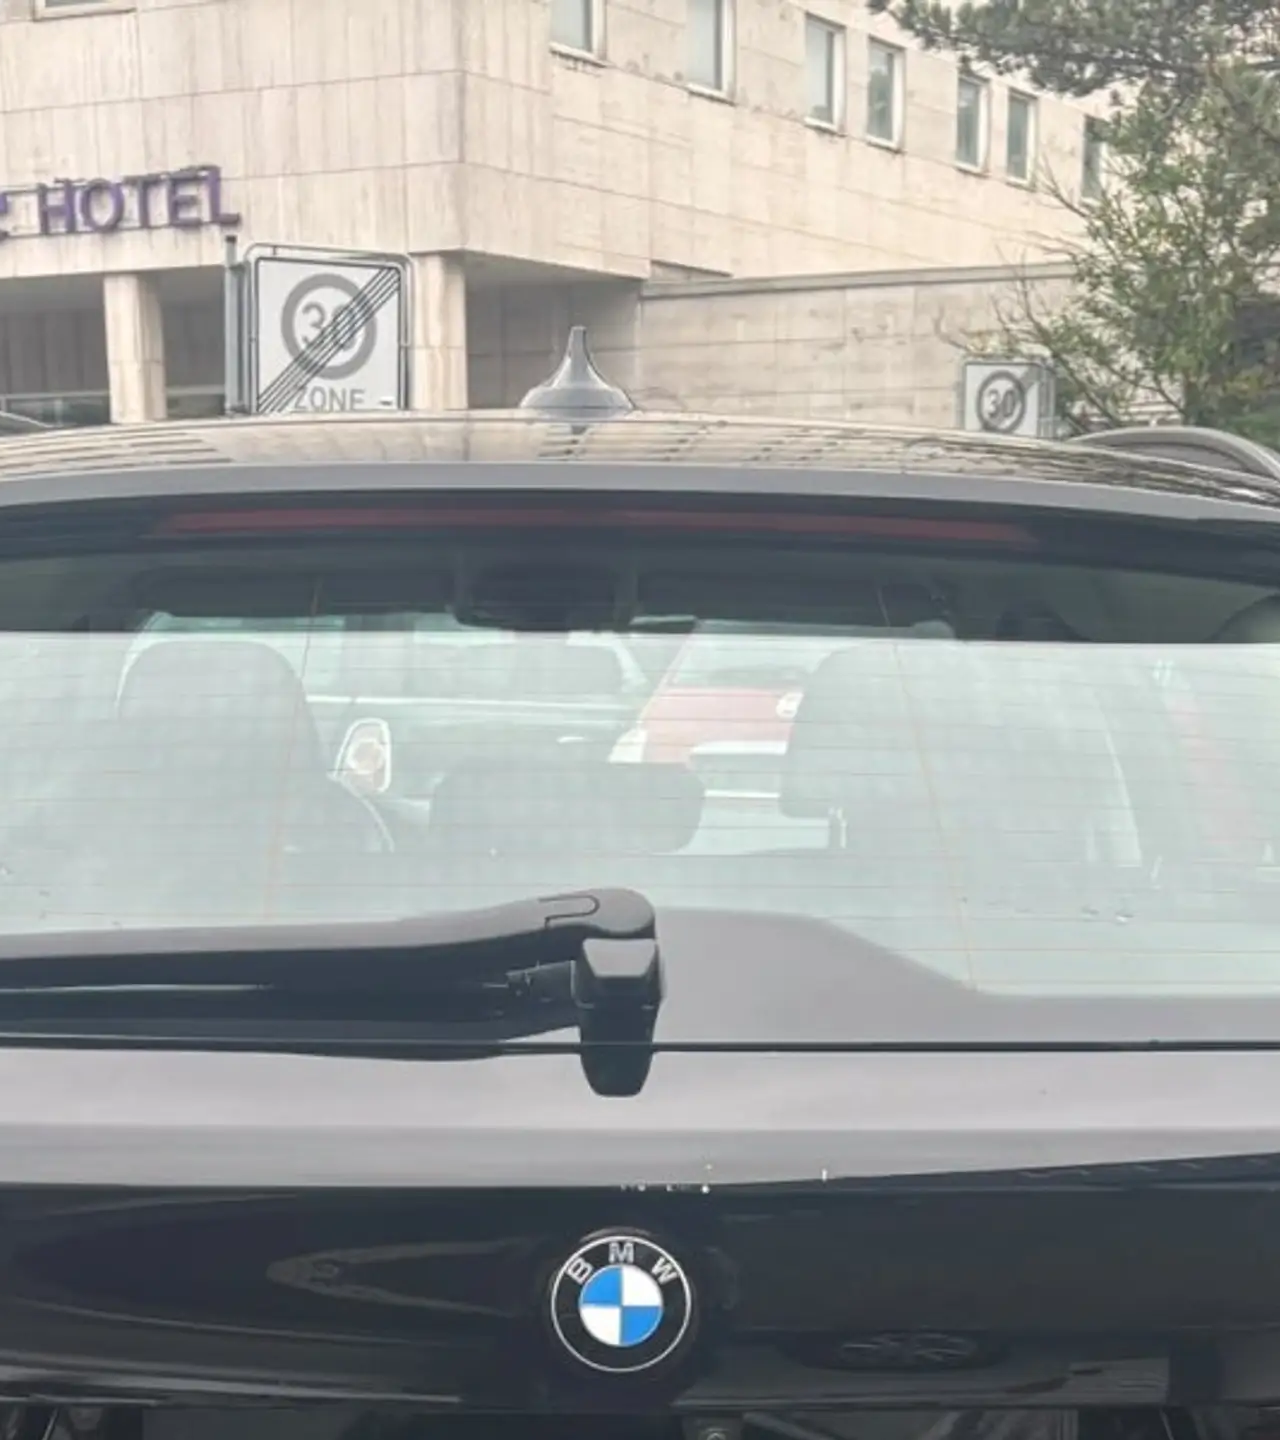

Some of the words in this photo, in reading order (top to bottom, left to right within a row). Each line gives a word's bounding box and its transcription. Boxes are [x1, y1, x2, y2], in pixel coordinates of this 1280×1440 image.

[38, 165, 241, 235] HOTEL
[293, 386, 366, 411] ZONE
[565, 1242, 678, 1286] BMW
